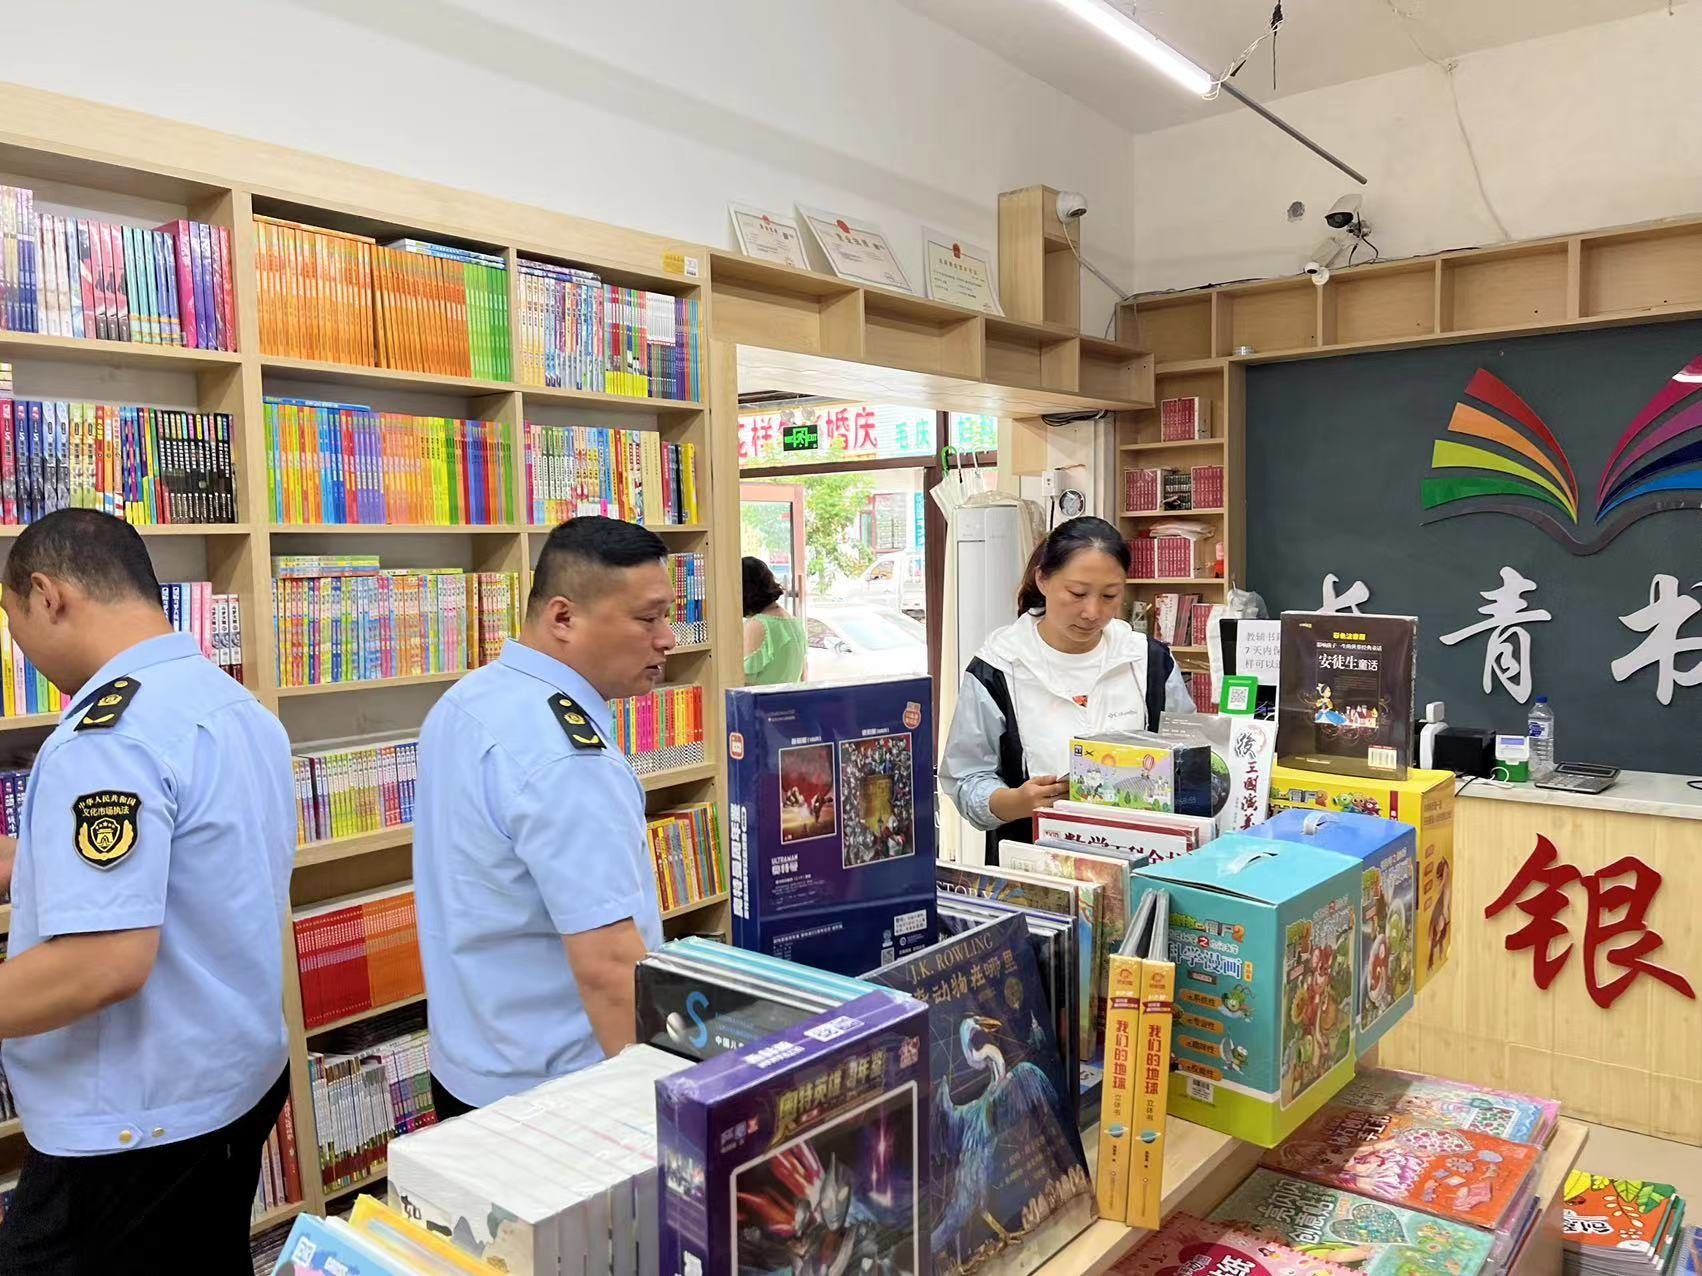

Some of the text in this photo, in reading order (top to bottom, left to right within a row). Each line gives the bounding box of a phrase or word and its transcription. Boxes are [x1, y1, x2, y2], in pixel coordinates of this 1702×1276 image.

[1318, 653, 1379, 671] 安徒生童话
[78, 794, 137, 810] 中华人民共和国
[82, 805, 130, 817] 文化市场执法
[1484, 833, 1696, 1010] 银
[910, 931, 993, 985] J.K. ROWLING
[1112, 1019, 1129, 1090] 我们的地球
[1144, 1024, 1161, 1095] 我们的地球
